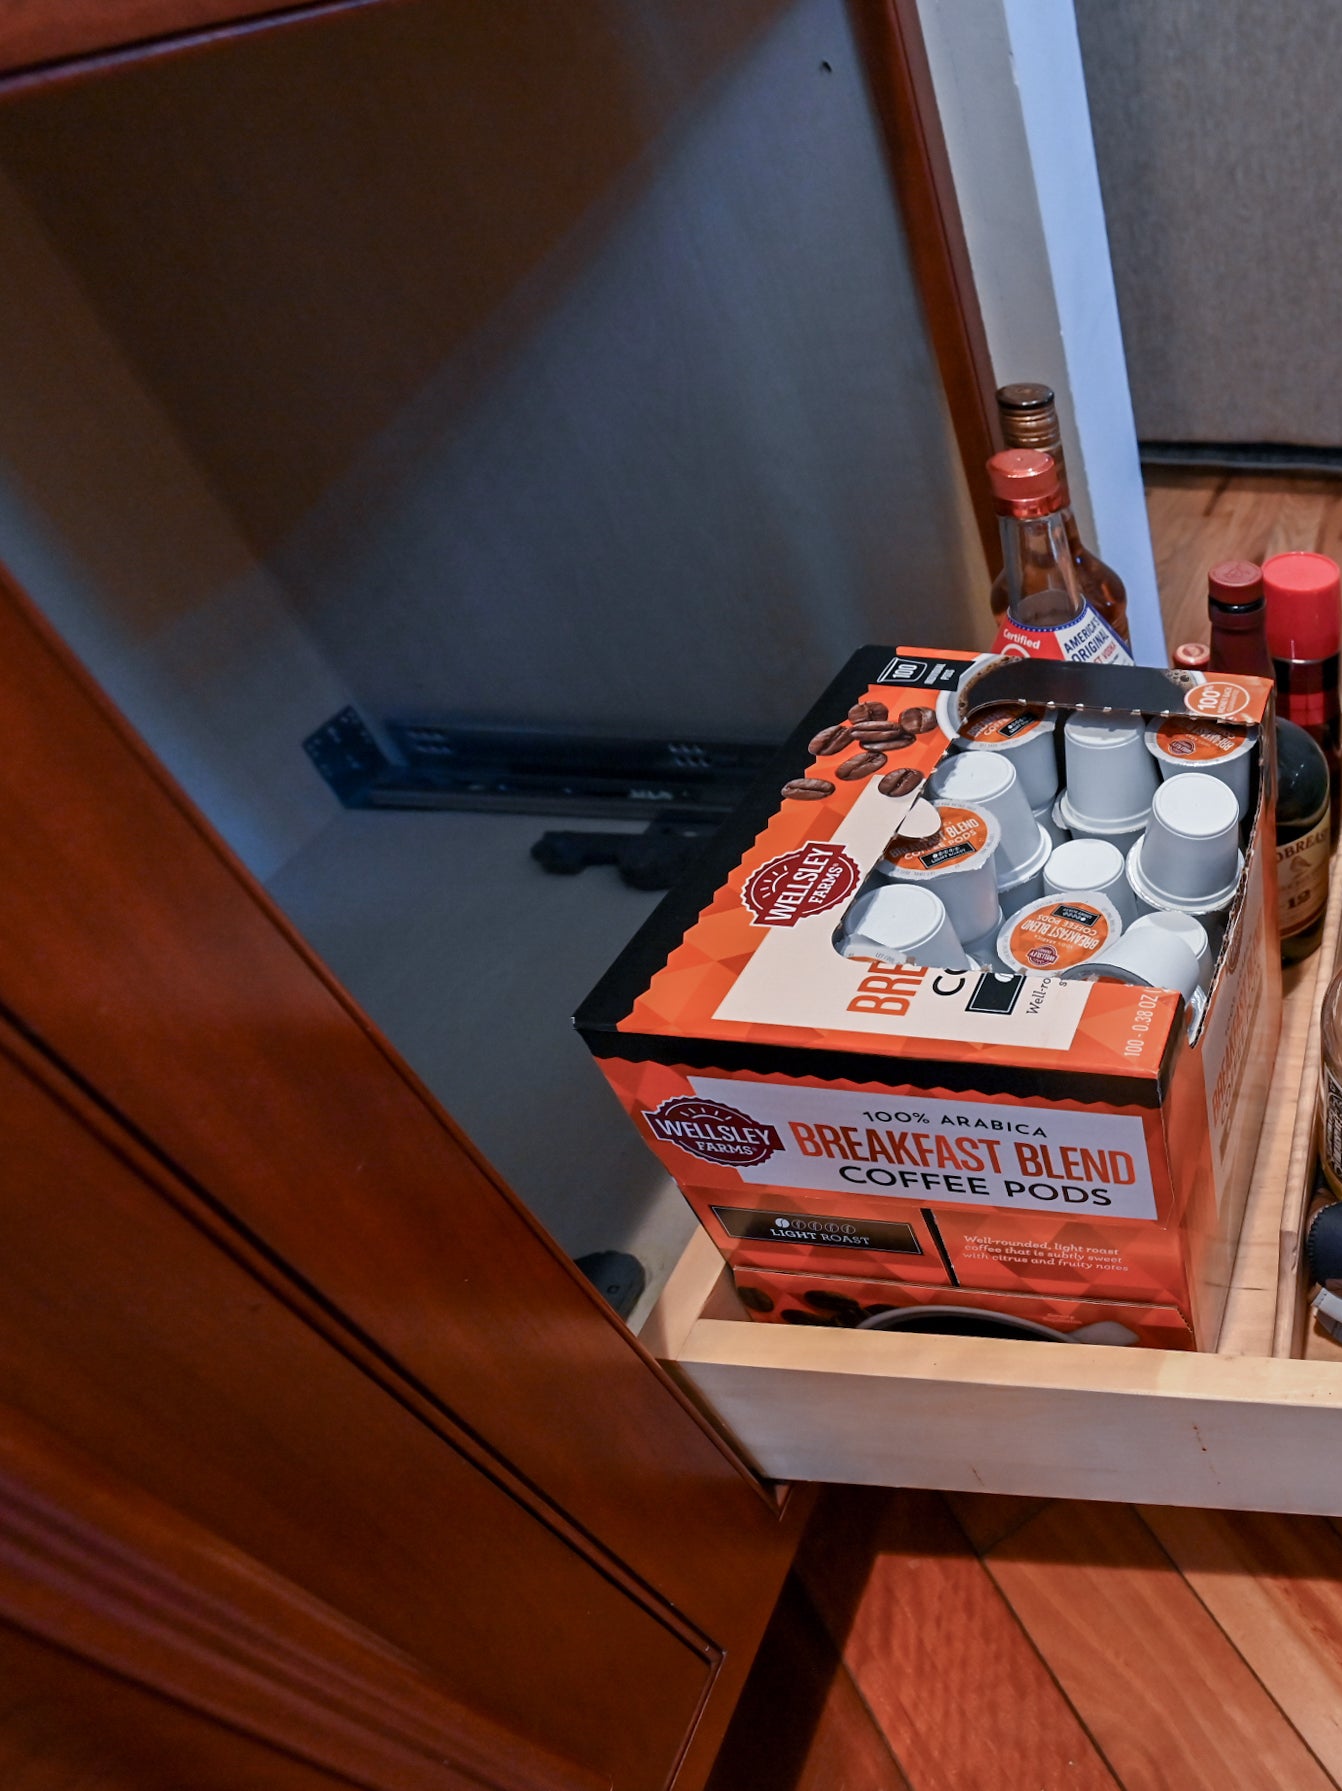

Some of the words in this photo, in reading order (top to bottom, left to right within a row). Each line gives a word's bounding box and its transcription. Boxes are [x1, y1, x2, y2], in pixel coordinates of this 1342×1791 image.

[1003, 628, 1040, 650] Certified
[1063, 616, 1100, 654] AMERICA'S
[1071, 627, 1109, 662] ORIGINAL
[892, 663, 918, 679] 100
[945, 818, 980, 838] BLEND
[764, 847, 833, 920] WELLSLEY
[808, 866, 843, 903] FARMS
[1021, 919, 1051, 936] BLEND
[1037, 914, 1061, 925] PODS
[1062, 921, 1097, 936] COFFEE
[1049, 926, 1100, 950] BREAKFAST
[1138, 994, 1159, 1009] OZ
[1131, 1010, 1153, 1032] 0.38
[1123, 1039, 1145, 1057] 100
[655, 1118, 770, 1145] WELLSLEY
[863, 1111, 930, 1124] 100%
[941, 1115, 1047, 1138] ARABICA
[697, 1141, 753, 1155] FARMS
[788, 1121, 1002, 1174] BREAKFAST
[1014, 1142, 1136, 1185] BLEND
[839, 1165, 990, 1196] COFFEE
[1004, 1180, 1112, 1206] PODS
[770, 1228, 817, 1240] LIGHT
[820, 1233, 870, 1245] ROAST
[963, 1235, 1052, 1250] Well-rounded,
[1054, 1242, 1083, 1253] light
[1086, 1247, 1120, 1255] roast
[962, 1252, 989, 1260] with
[992, 1254, 1028, 1263] citrus
[1030, 1257, 1055, 1266] and
[1057, 1259, 1093, 1270] fruity
[1096, 1263, 1129, 1272] notes
[964, 1244, 1002, 1254] coffee
[1005, 1247, 1031, 1256] that
[1033, 1249, 1045, 1257] is
[1047, 1250, 1085, 1261] subtly
[1087, 1255, 1122, 1264] sweet
